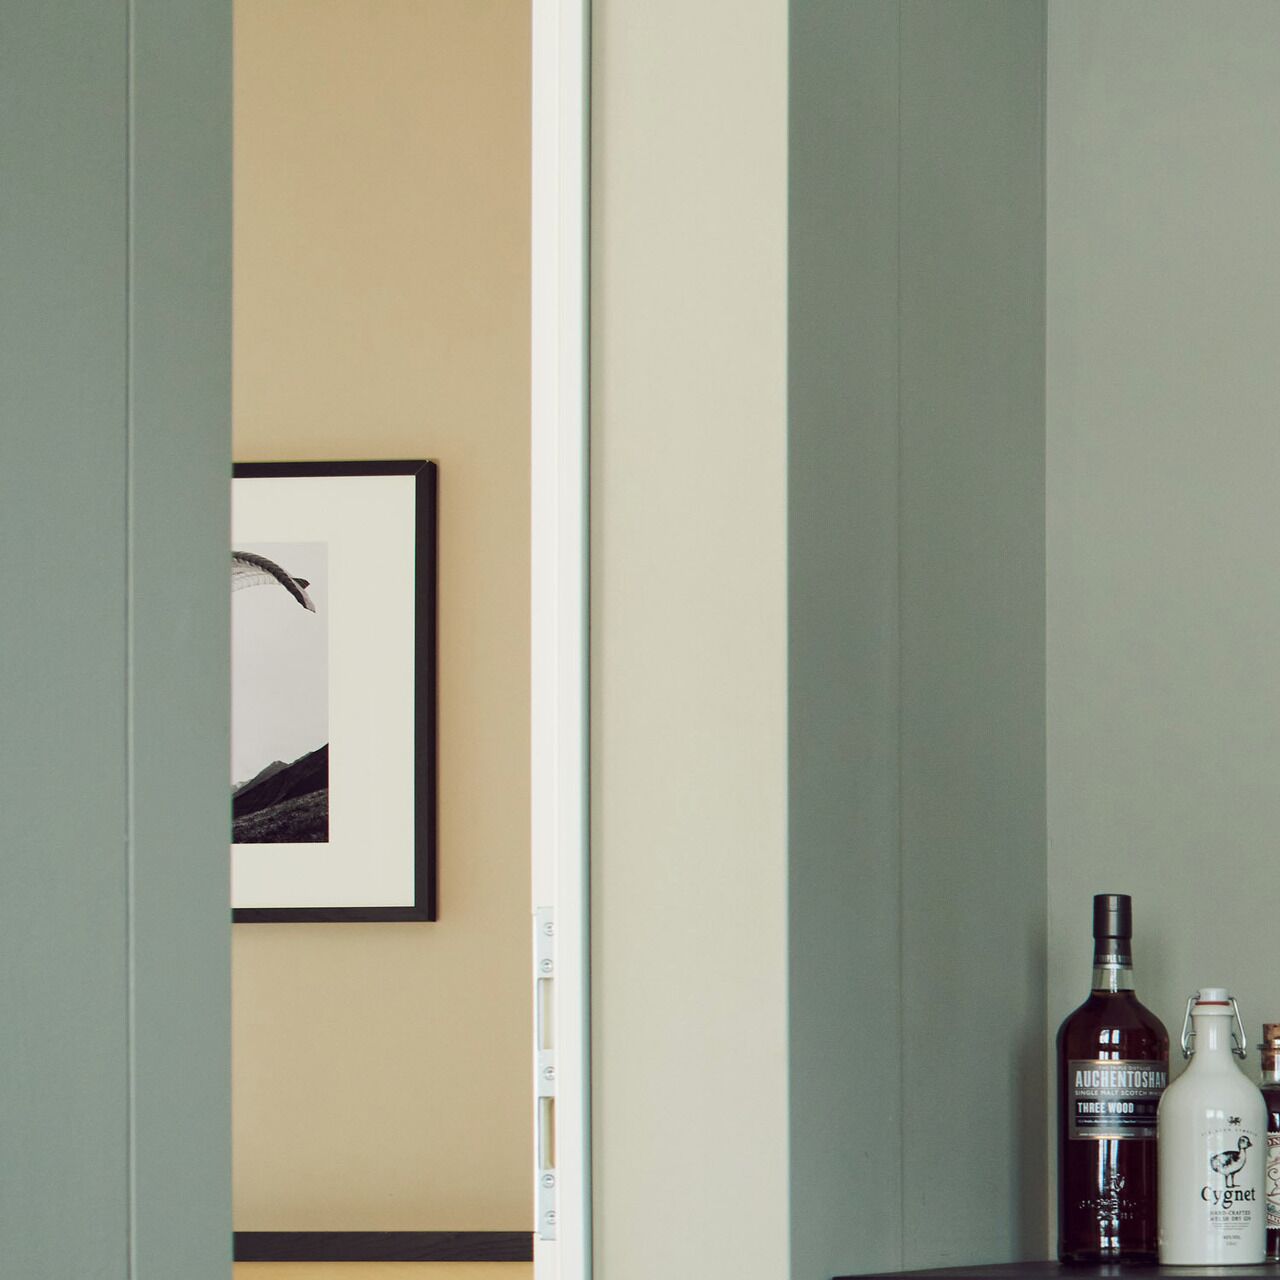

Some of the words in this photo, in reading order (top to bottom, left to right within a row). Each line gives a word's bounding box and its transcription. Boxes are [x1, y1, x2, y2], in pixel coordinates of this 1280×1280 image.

[1075, 1070, 1167, 1088] AUCHENTOSHAN
[1077, 1102, 1106, 1113] THREE
[1107, 1102, 1134, 1114] WOOD
[1200, 1186, 1256, 1210] Cygnet
